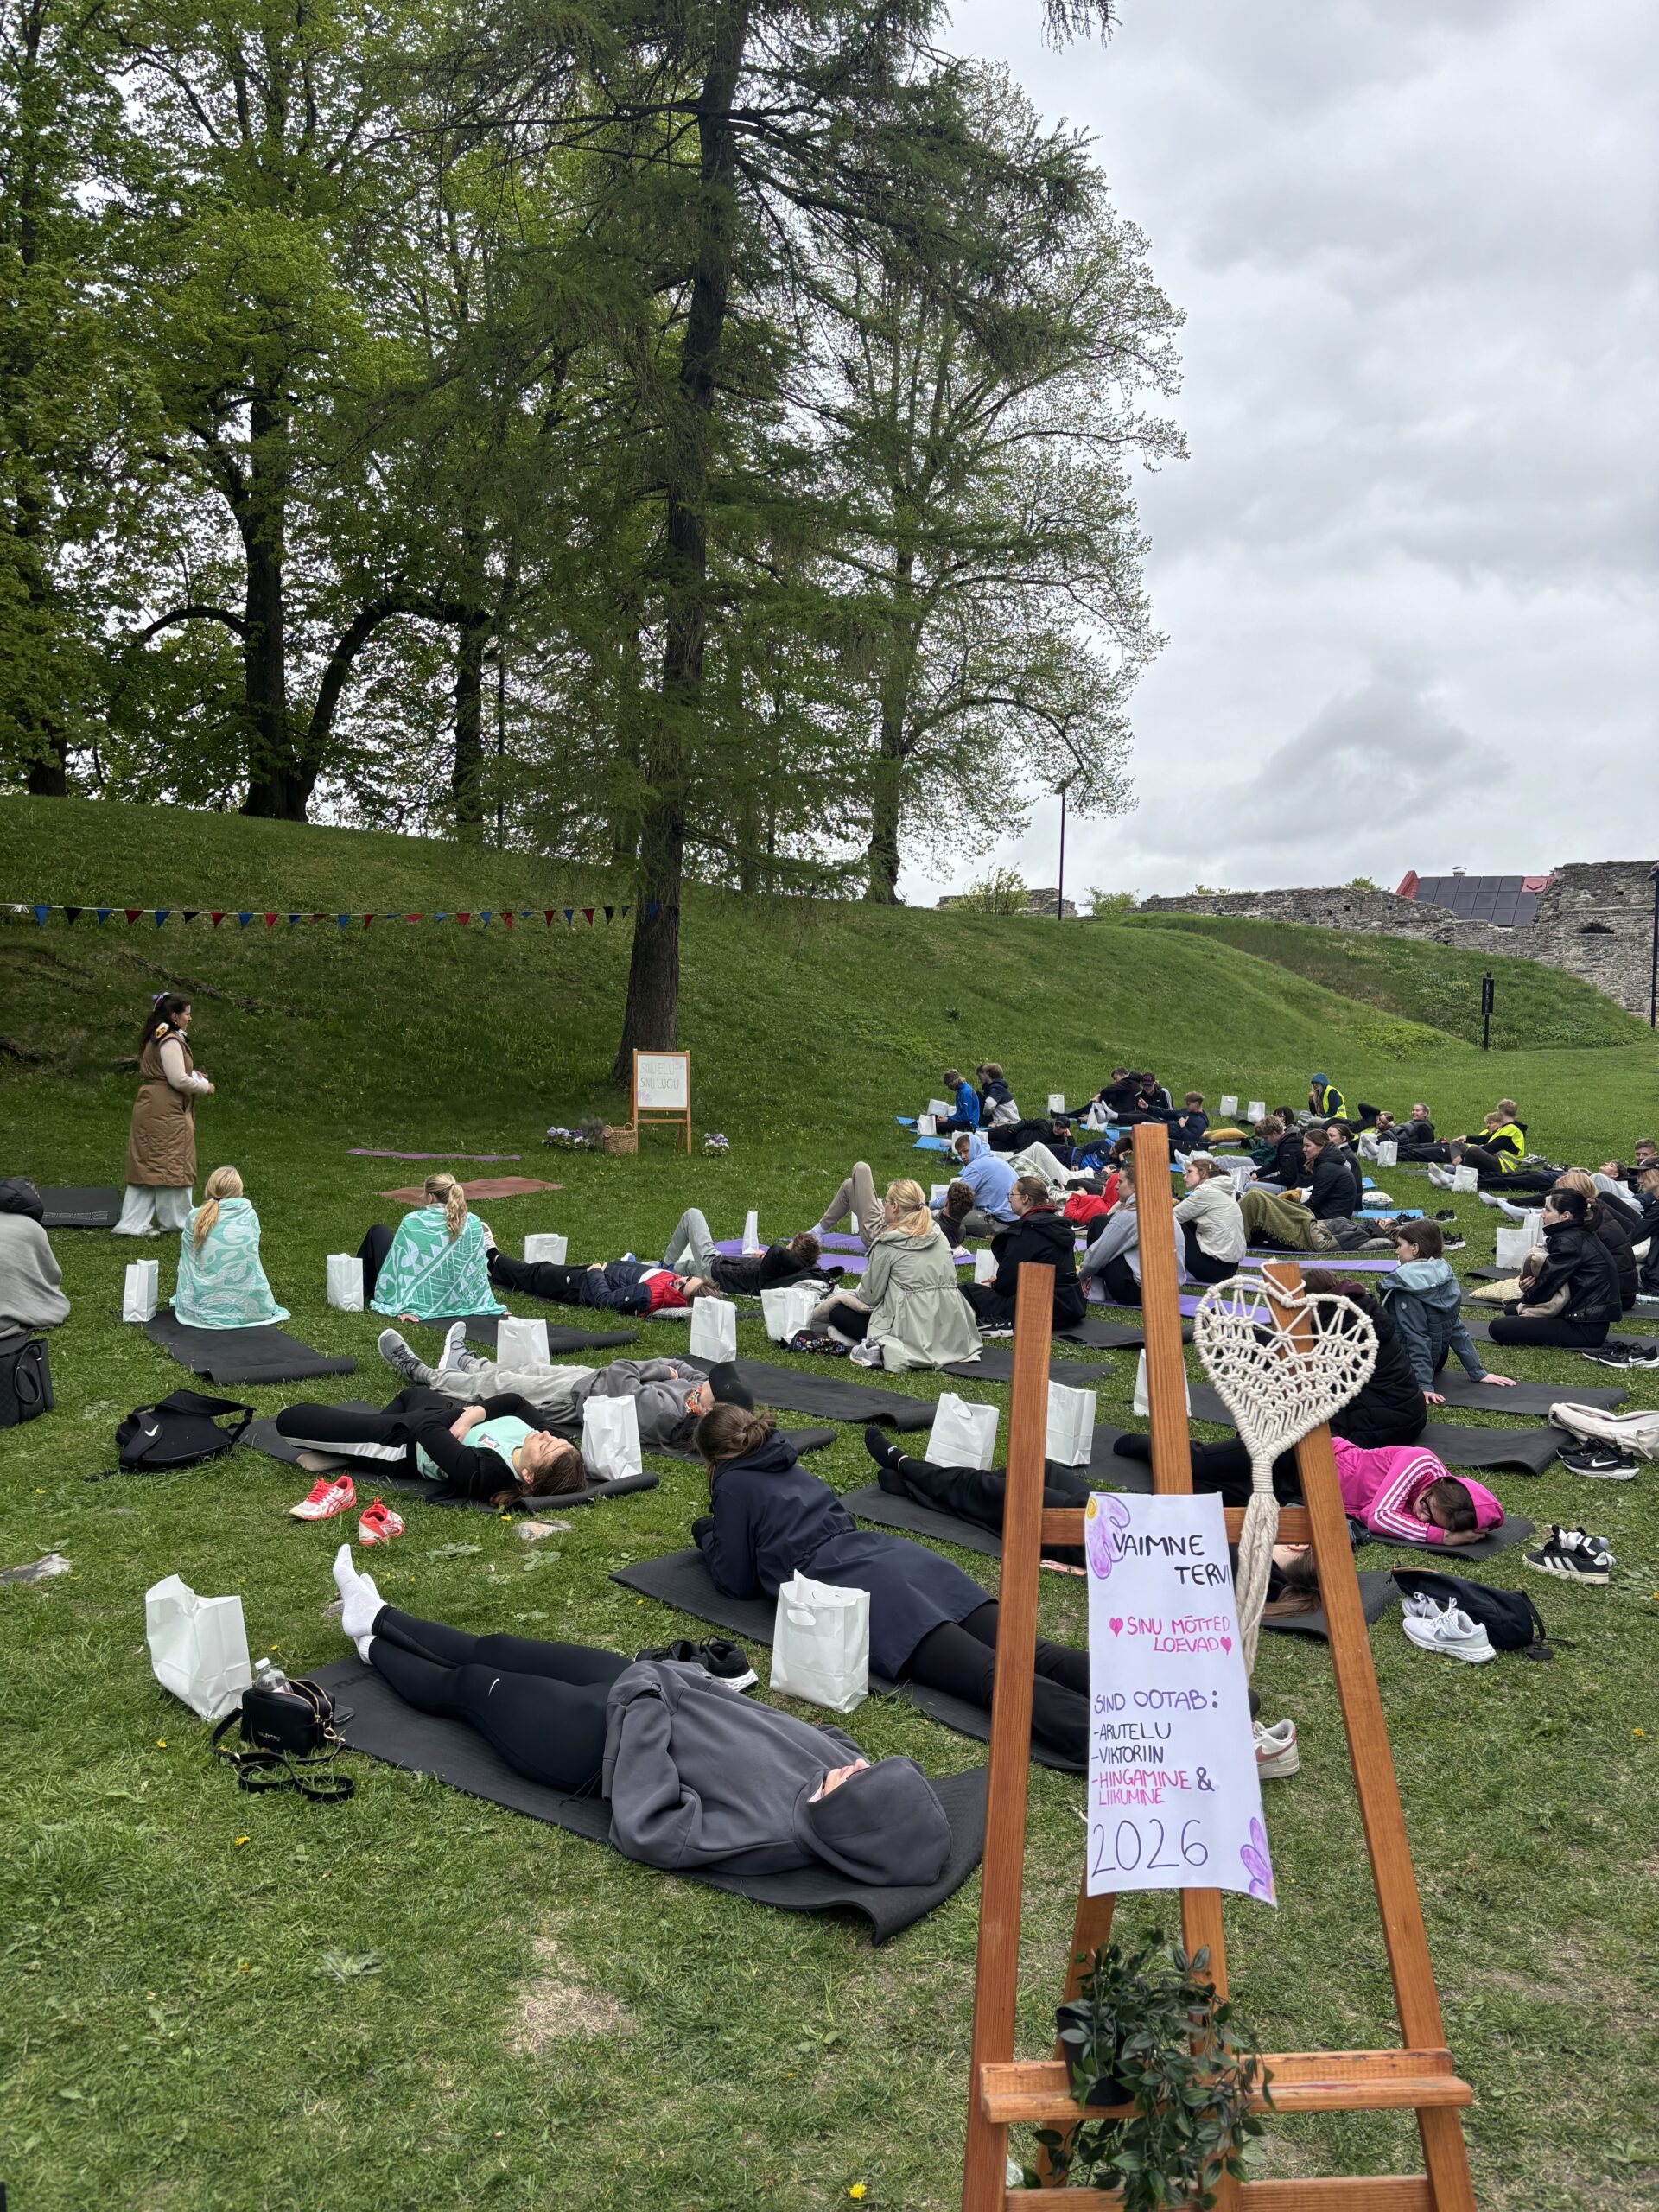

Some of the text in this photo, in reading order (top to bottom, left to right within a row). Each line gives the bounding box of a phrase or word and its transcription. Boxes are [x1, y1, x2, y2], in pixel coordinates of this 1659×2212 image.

[640, 1077, 679, 1090] SINU LUGU
[1112, 1532, 1205, 1557] VAIMNE
[1127, 1616, 1162, 1636] SINU
[1154, 1637, 1220, 1653] LOEVAD
[1094, 1693, 1126, 1714] SIND
[1196, 1766, 1215, 1792] &
[1098, 1787, 1166, 1807] LIIKUMINE
[1092, 1818, 1209, 1878] 2026
